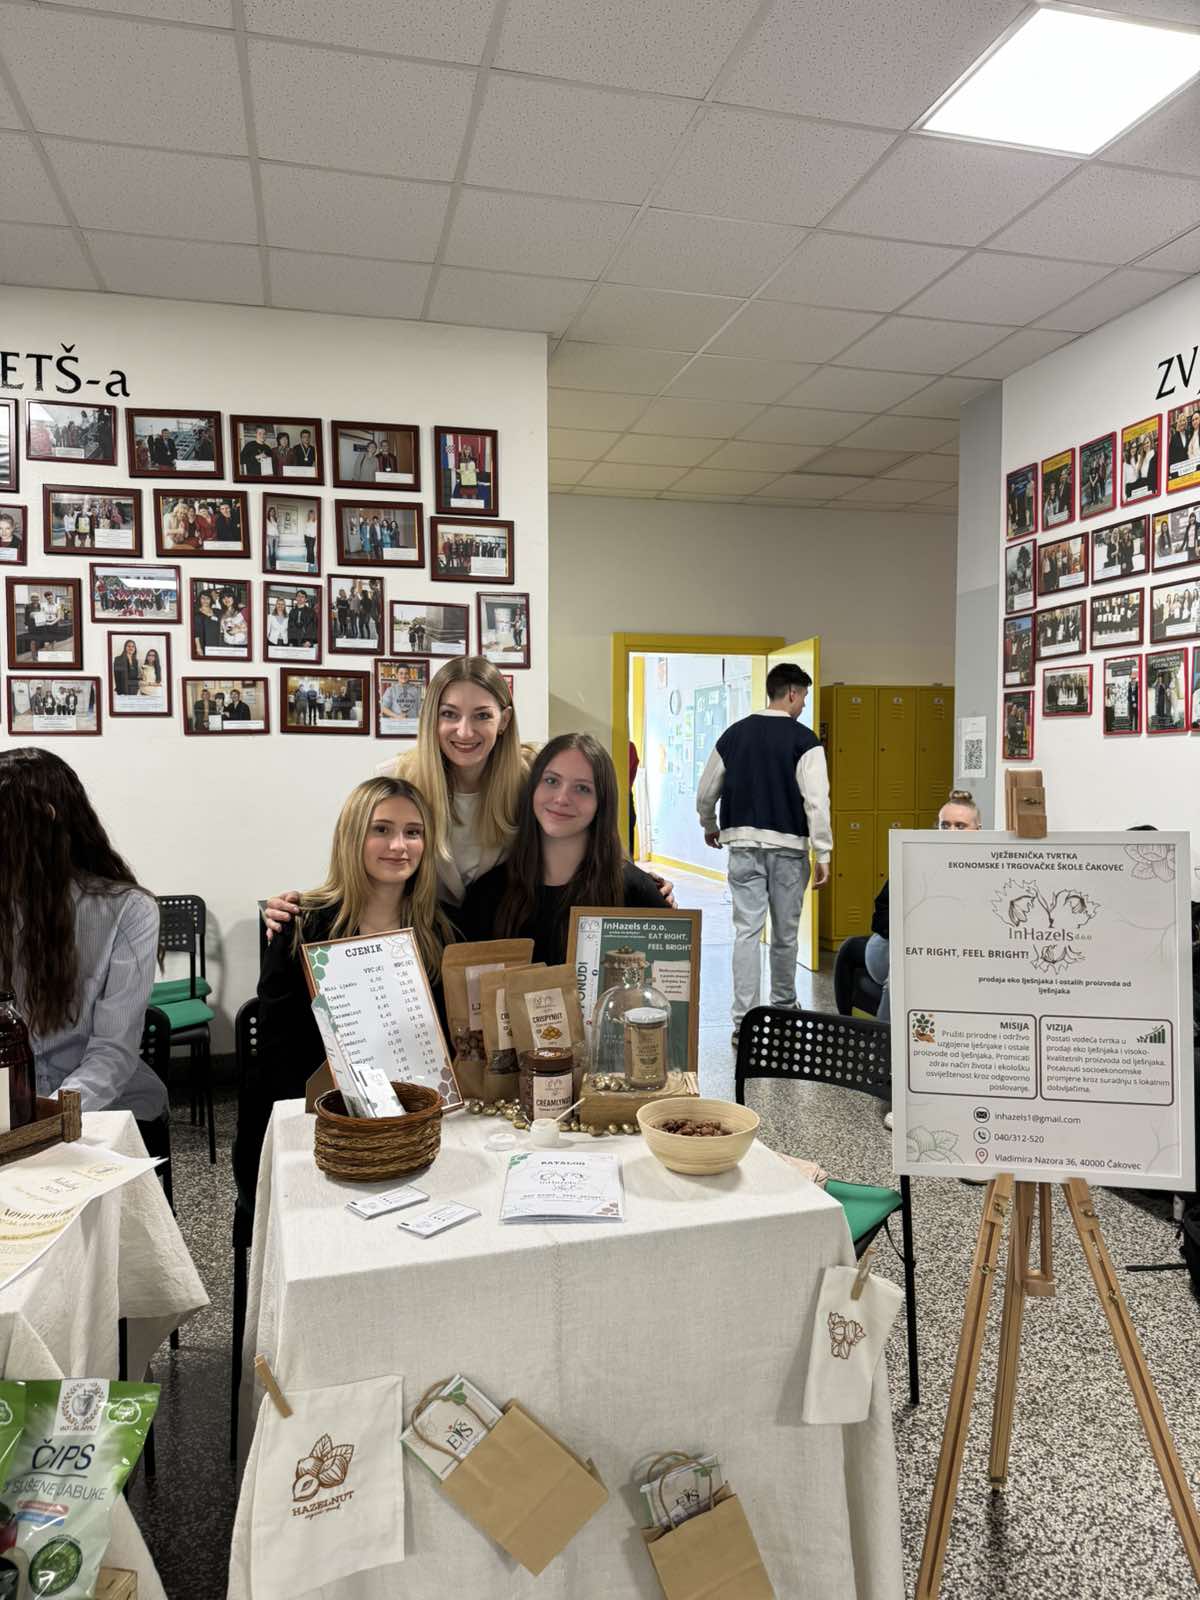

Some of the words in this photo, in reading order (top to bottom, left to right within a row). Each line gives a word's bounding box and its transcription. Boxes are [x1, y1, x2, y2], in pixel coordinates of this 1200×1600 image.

[1155, 345, 1200, 400] ZV
[991, 851, 1044, 860] VJEŽBENIČKA
[1046, 852, 1078, 860] TVRTKA
[948, 861, 1000, 870] EKONOMSKE
[1001, 862, 1005, 870] I
[1006, 861, 1055, 871] TRGOVAČKE
[1057, 861, 1083, 871] ŠKOLE
[1085, 861, 1125, 872] ČAKOVEC
[603, 921, 642, 931] InHazels
[643, 922, 667, 931] d.o.o.
[1008, 927, 1074, 942] InHazels
[345, 944, 384, 958] CJENIK
[905, 946, 924, 956] EAT
[926, 947, 960, 958] RIGHT,
[962, 949, 986, 959] FEEL
[988, 950, 1030, 960] BRIGHT!
[978, 976, 1006, 985] prodaja
[1021, 977, 1054, 986] lješnjaka
[1059, 978, 1084, 986] ostalih
[1085, 980, 1120, 989] proizvoda
[1122, 980, 1132, 988] od
[1038, 987, 1071, 996] lješnjaka
[1000, 1021, 1030, 1032] MISIJA
[1046, 1023, 1073, 1033] VIZIJA
[942, 1030, 965, 1038] Pružiti
[966, 1031, 997, 1041] prirodne
[1002, 1032, 1030, 1041] održivo
[1046, 1034, 1071, 1042] Postati
[1071, 1035, 1098, 1043] vodeća
[1098, 1037, 1120, 1045] tvrtka
[937, 1041, 970, 1051] uzgojene
[971, 1042, 1002, 1052] lješnjake
[1046, 1045, 1071, 1053] prodaji
[1072, 1045, 1086, 1053] eko
[1087, 1046, 1119, 1056] lješnjaka
[913, 1048, 948, 1058] proizvode
[949, 1050, 960, 1058] od
[995, 1052, 1030, 1061] Promicati
[1046, 1055, 1083, 1063] kvalitetnih
[1084, 1056, 1120, 1066] proizvoda
[1121, 1057, 1132, 1065] od
[929, 1060, 949, 1068] zdrav
[950, 1061, 970, 1069] način
[971, 1062, 993, 1070] života
[998, 1063, 1030, 1072] ekološku
[1046, 1064, 1081, 1072] Potaknuti
[1081, 1065, 1142, 1075] socioekonomske
[926, 1070, 972, 1080] osviještenost
[973, 1072, 990, 1080] kroz
[990, 1072, 1030, 1083] odgovorno
[1046, 1074, 1082, 1084] promjene
[1082, 1075, 1099, 1083] kroz
[1099, 1076, 1132, 1086] suradnju
[994, 1112, 1082, 1125] inhazels1@gmail.com
[993, 1133, 1045, 1144] 040/312-520
[994, 1153, 1034, 1164] Vladimira
[1034, 1154, 1064, 1165] Nazora
[1065, 1157, 1078, 1167] 36,
[1079, 1158, 1105, 1168] 40000
[1106, 1158, 1143, 1170] Čakovec
[31, 1439, 96, 1472] ČIPS
[13, 1477, 56, 1498] SUŠENE
[56, 1482, 108, 1501] JABUKE
[292, 1490, 354, 1516] HAZELNUT
